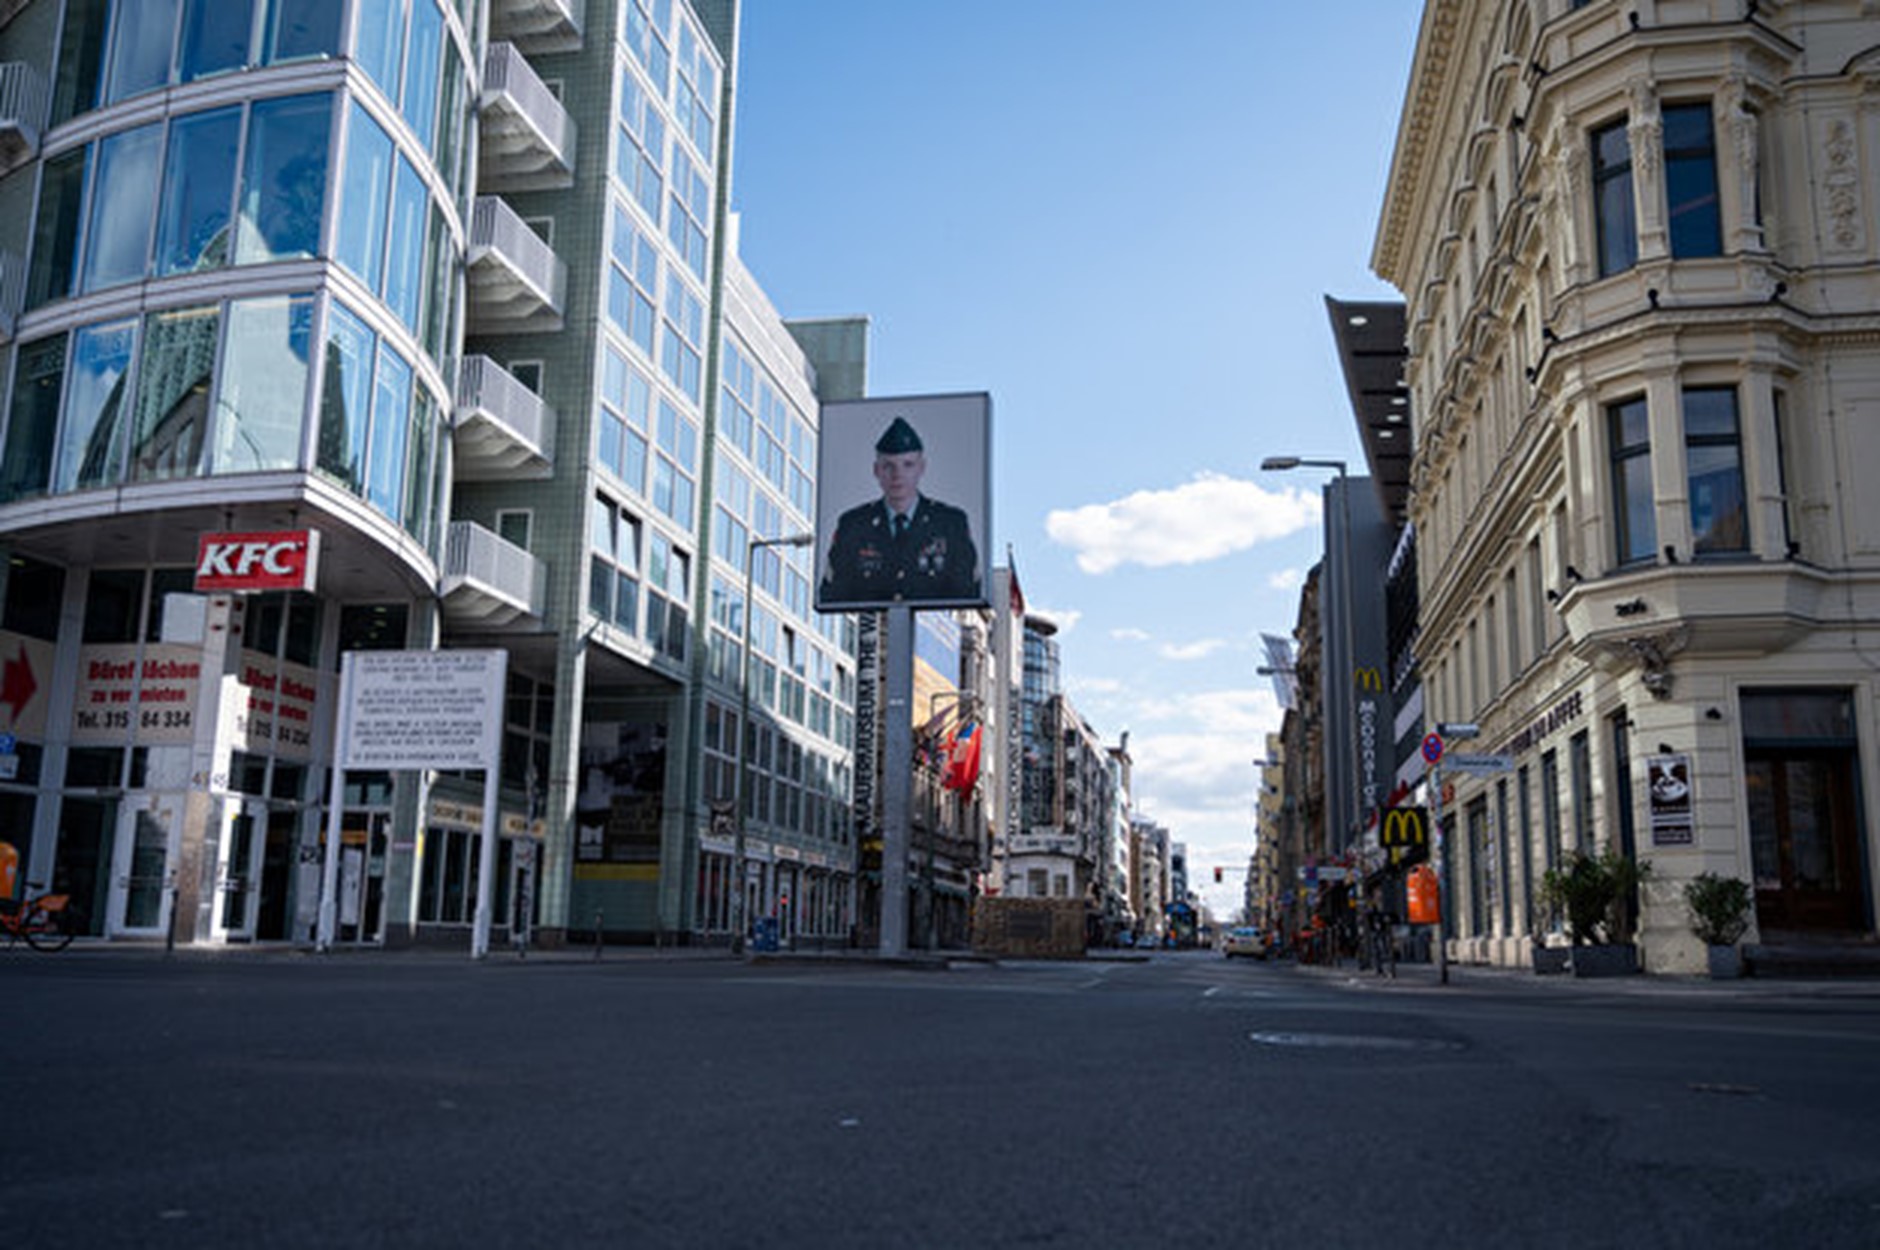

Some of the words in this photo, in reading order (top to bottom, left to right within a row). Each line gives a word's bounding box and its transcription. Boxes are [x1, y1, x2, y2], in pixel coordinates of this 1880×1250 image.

[199, 541, 298, 576] KFC
[104, 711, 129, 728] 315
[141, 711, 158, 728] 84
[164, 711, 190, 728] 334
